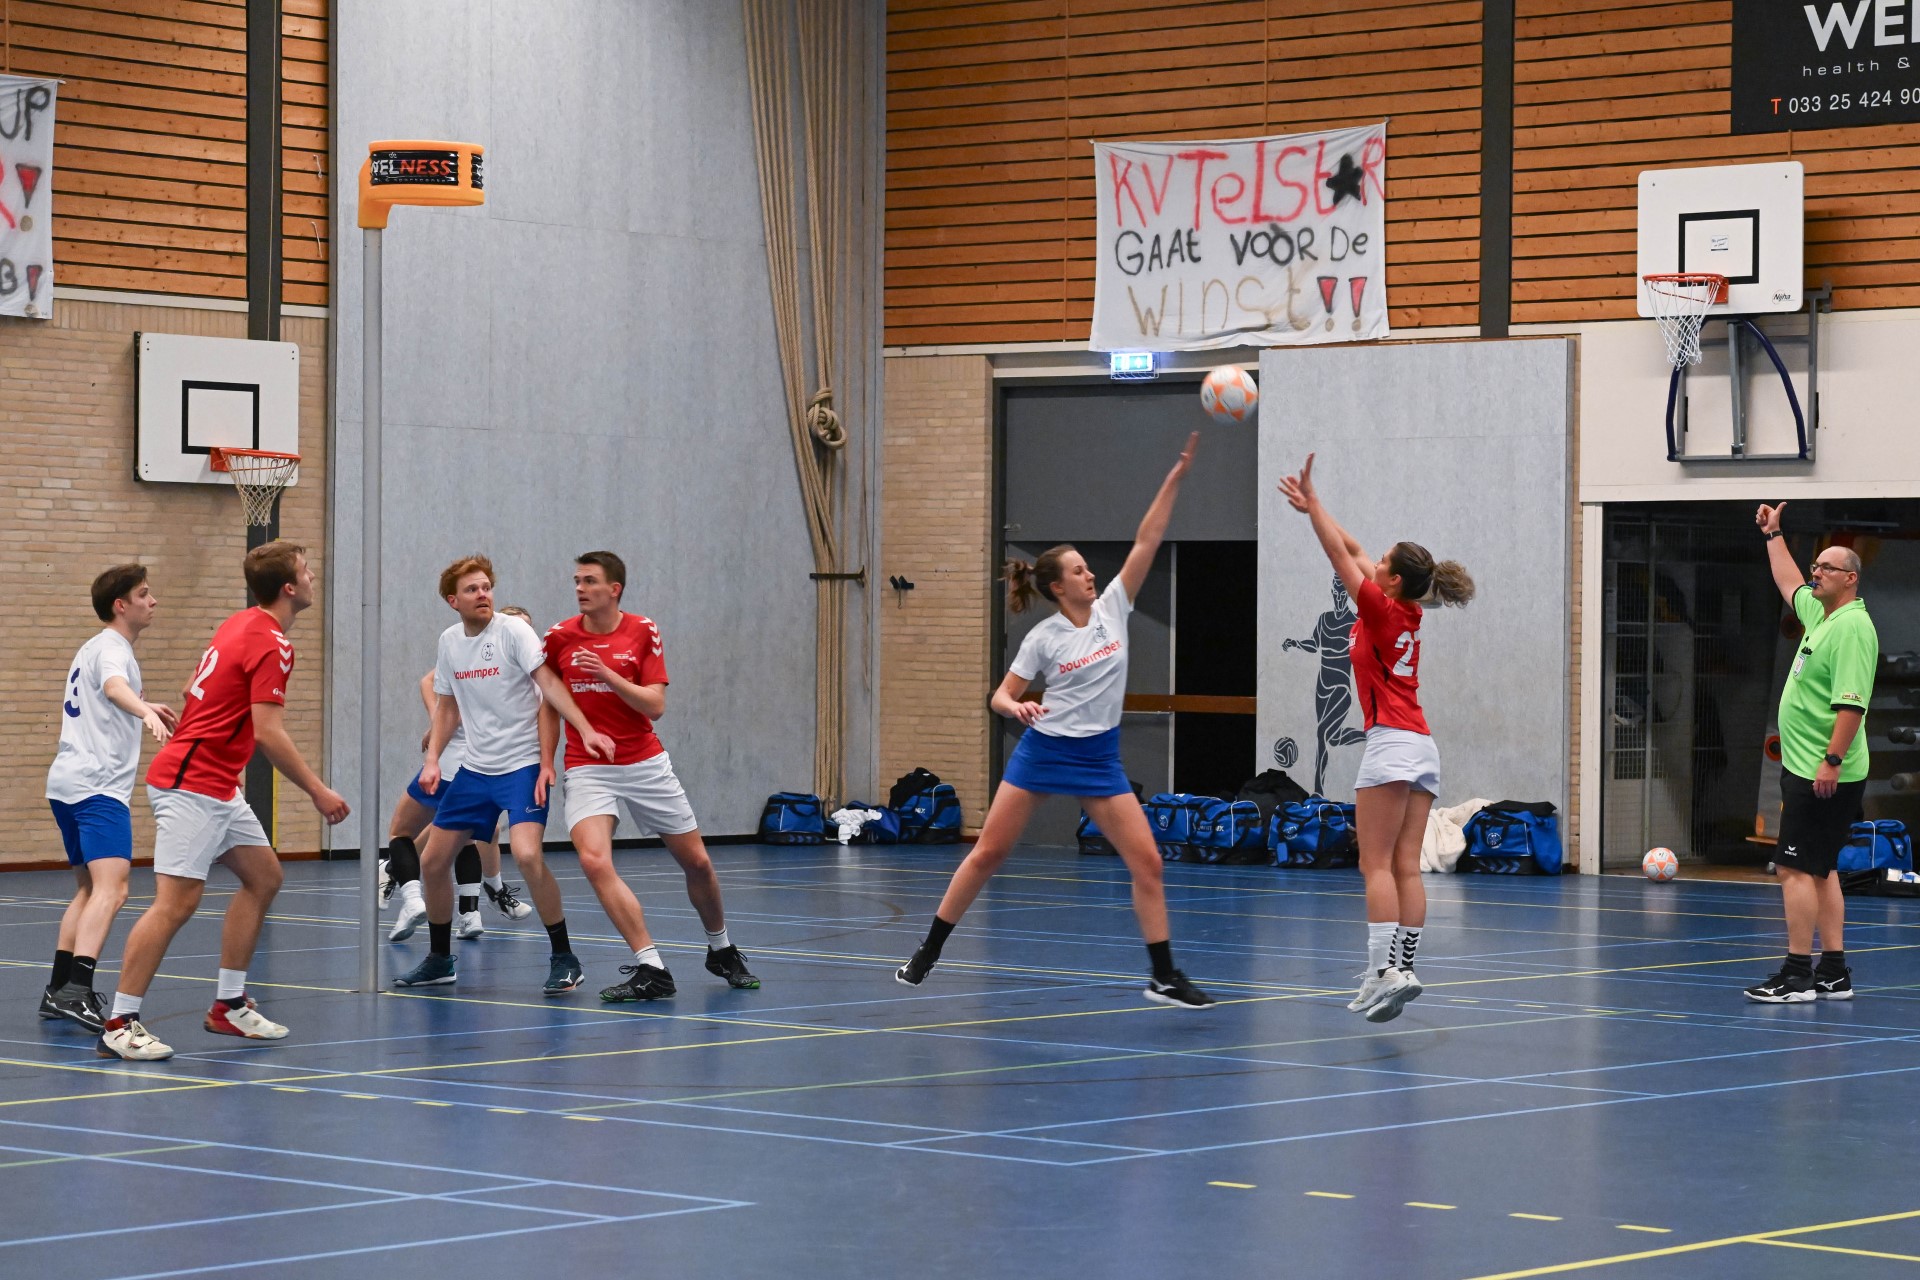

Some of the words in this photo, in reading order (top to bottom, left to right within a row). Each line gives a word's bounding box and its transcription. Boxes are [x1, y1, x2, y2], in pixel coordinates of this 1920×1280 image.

[1803, 0, 1920, 52] WE
[1802, 60, 1880, 77] health
[1897, 57, 1911, 69] &
[1771, 98, 1781, 115] T
[1788, 95, 1821, 114] 033
[1829, 93, 1851, 110] 25
[1858, 90, 1892, 108] 424
[1900, 87, 1920, 105] 90
[1330, 225, 1369, 262] De
